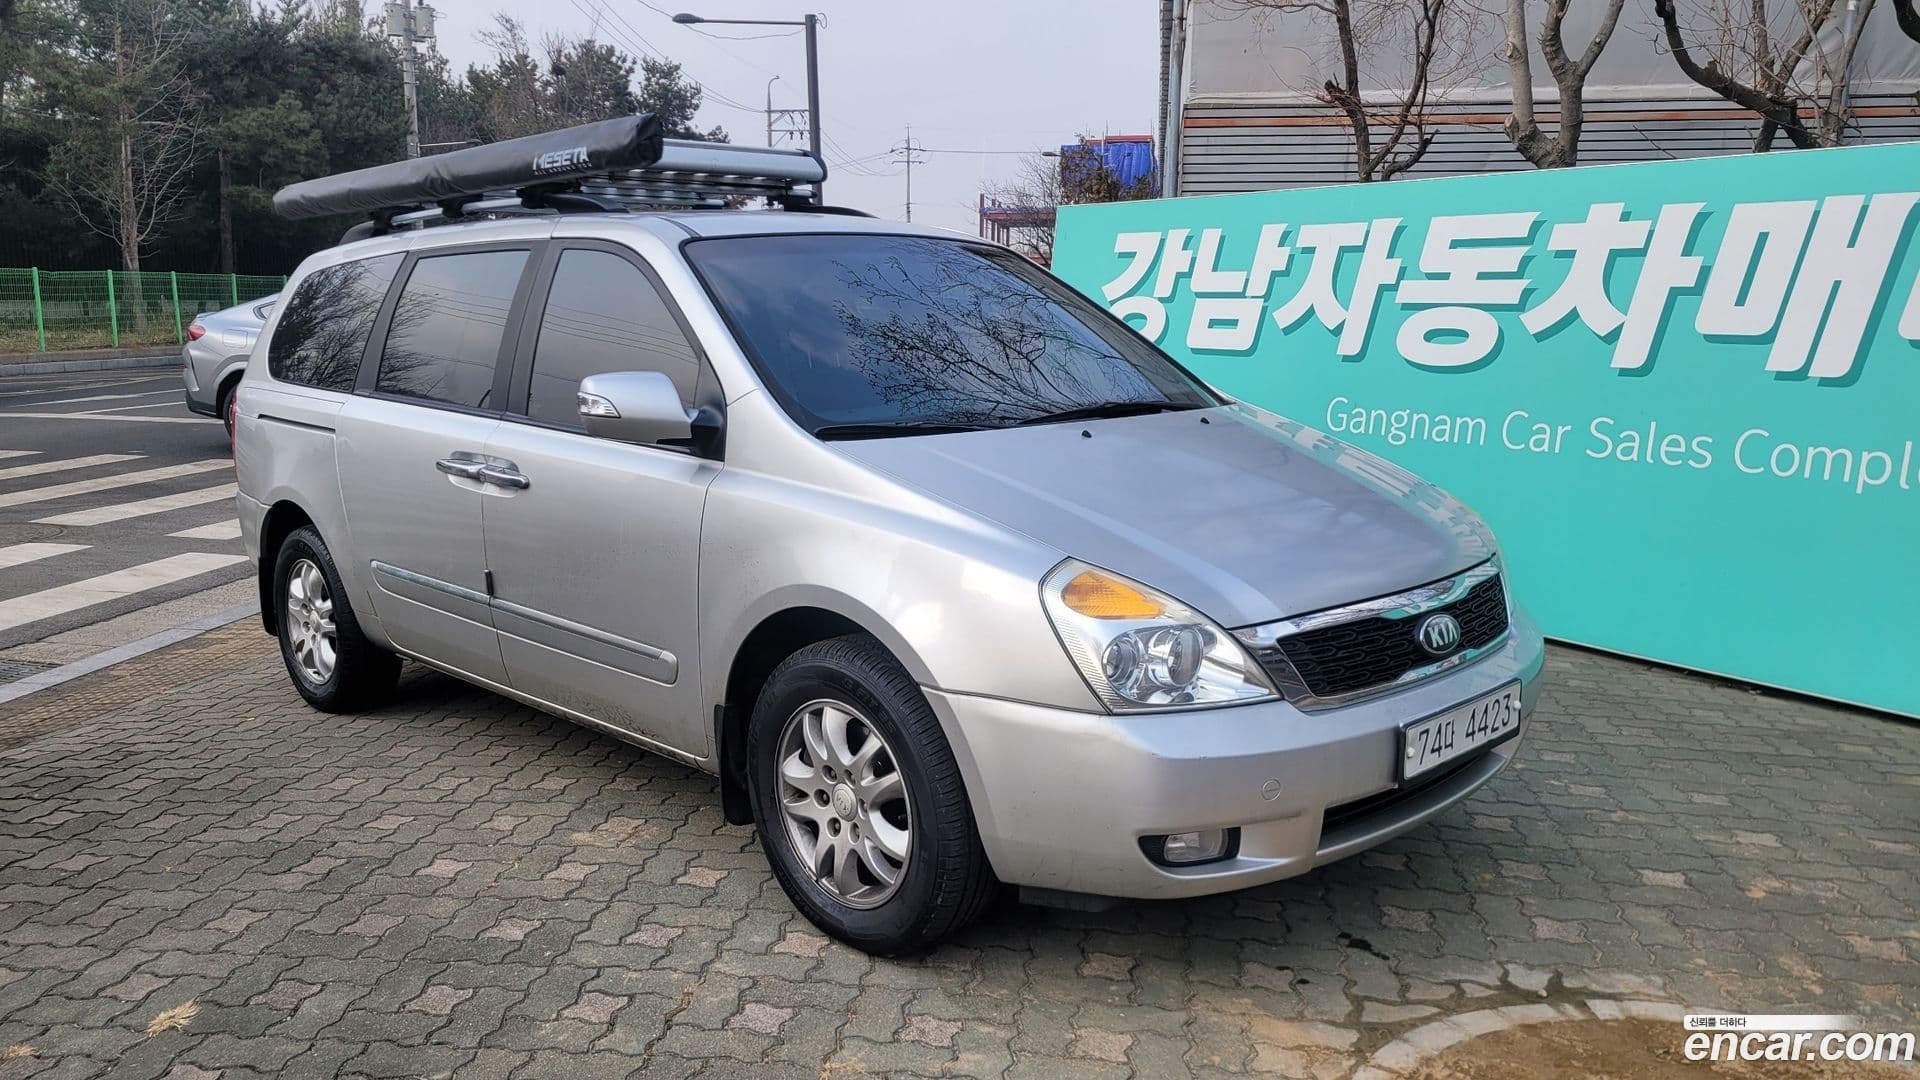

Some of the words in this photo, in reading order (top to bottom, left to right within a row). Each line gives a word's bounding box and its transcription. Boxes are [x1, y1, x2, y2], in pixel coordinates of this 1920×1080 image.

[533, 146, 589, 170] MESETA
[1101, 192, 1920, 378] 강남자동차매
[1326, 397, 1487, 445] Gangnam
[1502, 410, 1572, 454] Car
[1586, 416, 1714, 470] Sales
[1735, 428, 1920, 495] Compl
[1428, 622, 1458, 648] KIA
[1465, 692, 1512, 743] 4423
